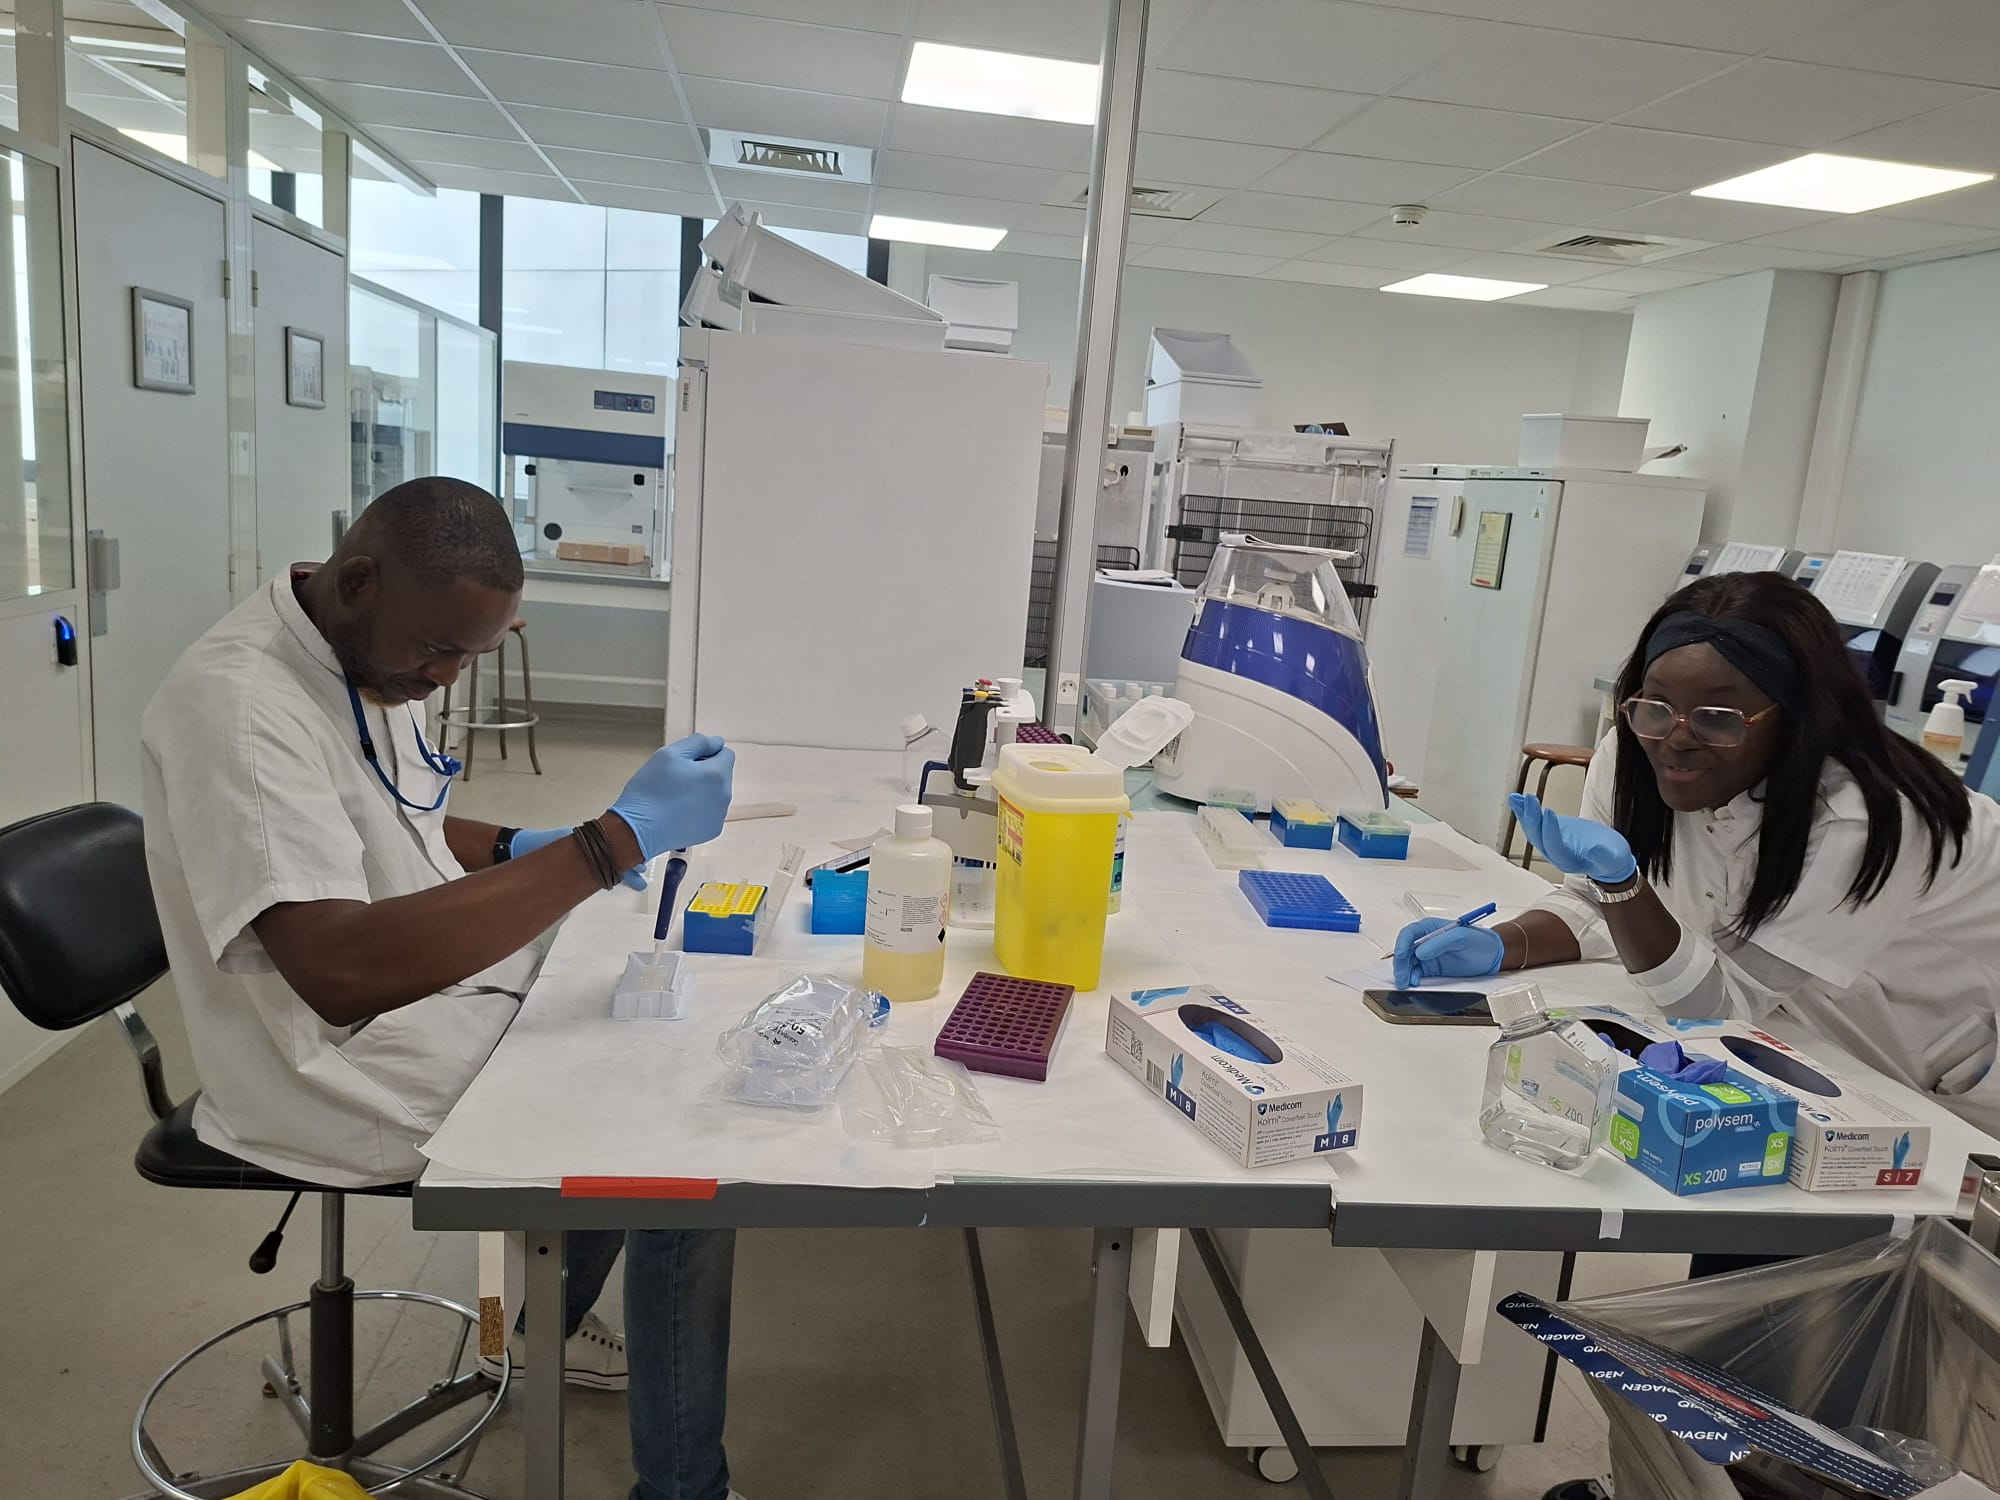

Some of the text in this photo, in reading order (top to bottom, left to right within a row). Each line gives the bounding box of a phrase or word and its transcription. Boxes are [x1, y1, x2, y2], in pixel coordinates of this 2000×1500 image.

[1636, 1074, 1700, 1105] polysem
[1169, 1088, 1177, 1101] M
[1185, 1100, 1191, 1112] 8
[1268, 1101, 1302, 1113] Medicom
[1694, 1113, 1753, 1132] polysem
[1320, 1134, 1349, 1148] M 8
[1619, 1135, 1633, 1152] XS
[1771, 1138, 1784, 1149] XS
[1836, 1132, 1870, 1141] Medicom
[1683, 1167, 1727, 1186] XS 200
[1883, 1172, 1913, 1182] S 7
[1537, 1333, 1586, 1341] QIAGEN
